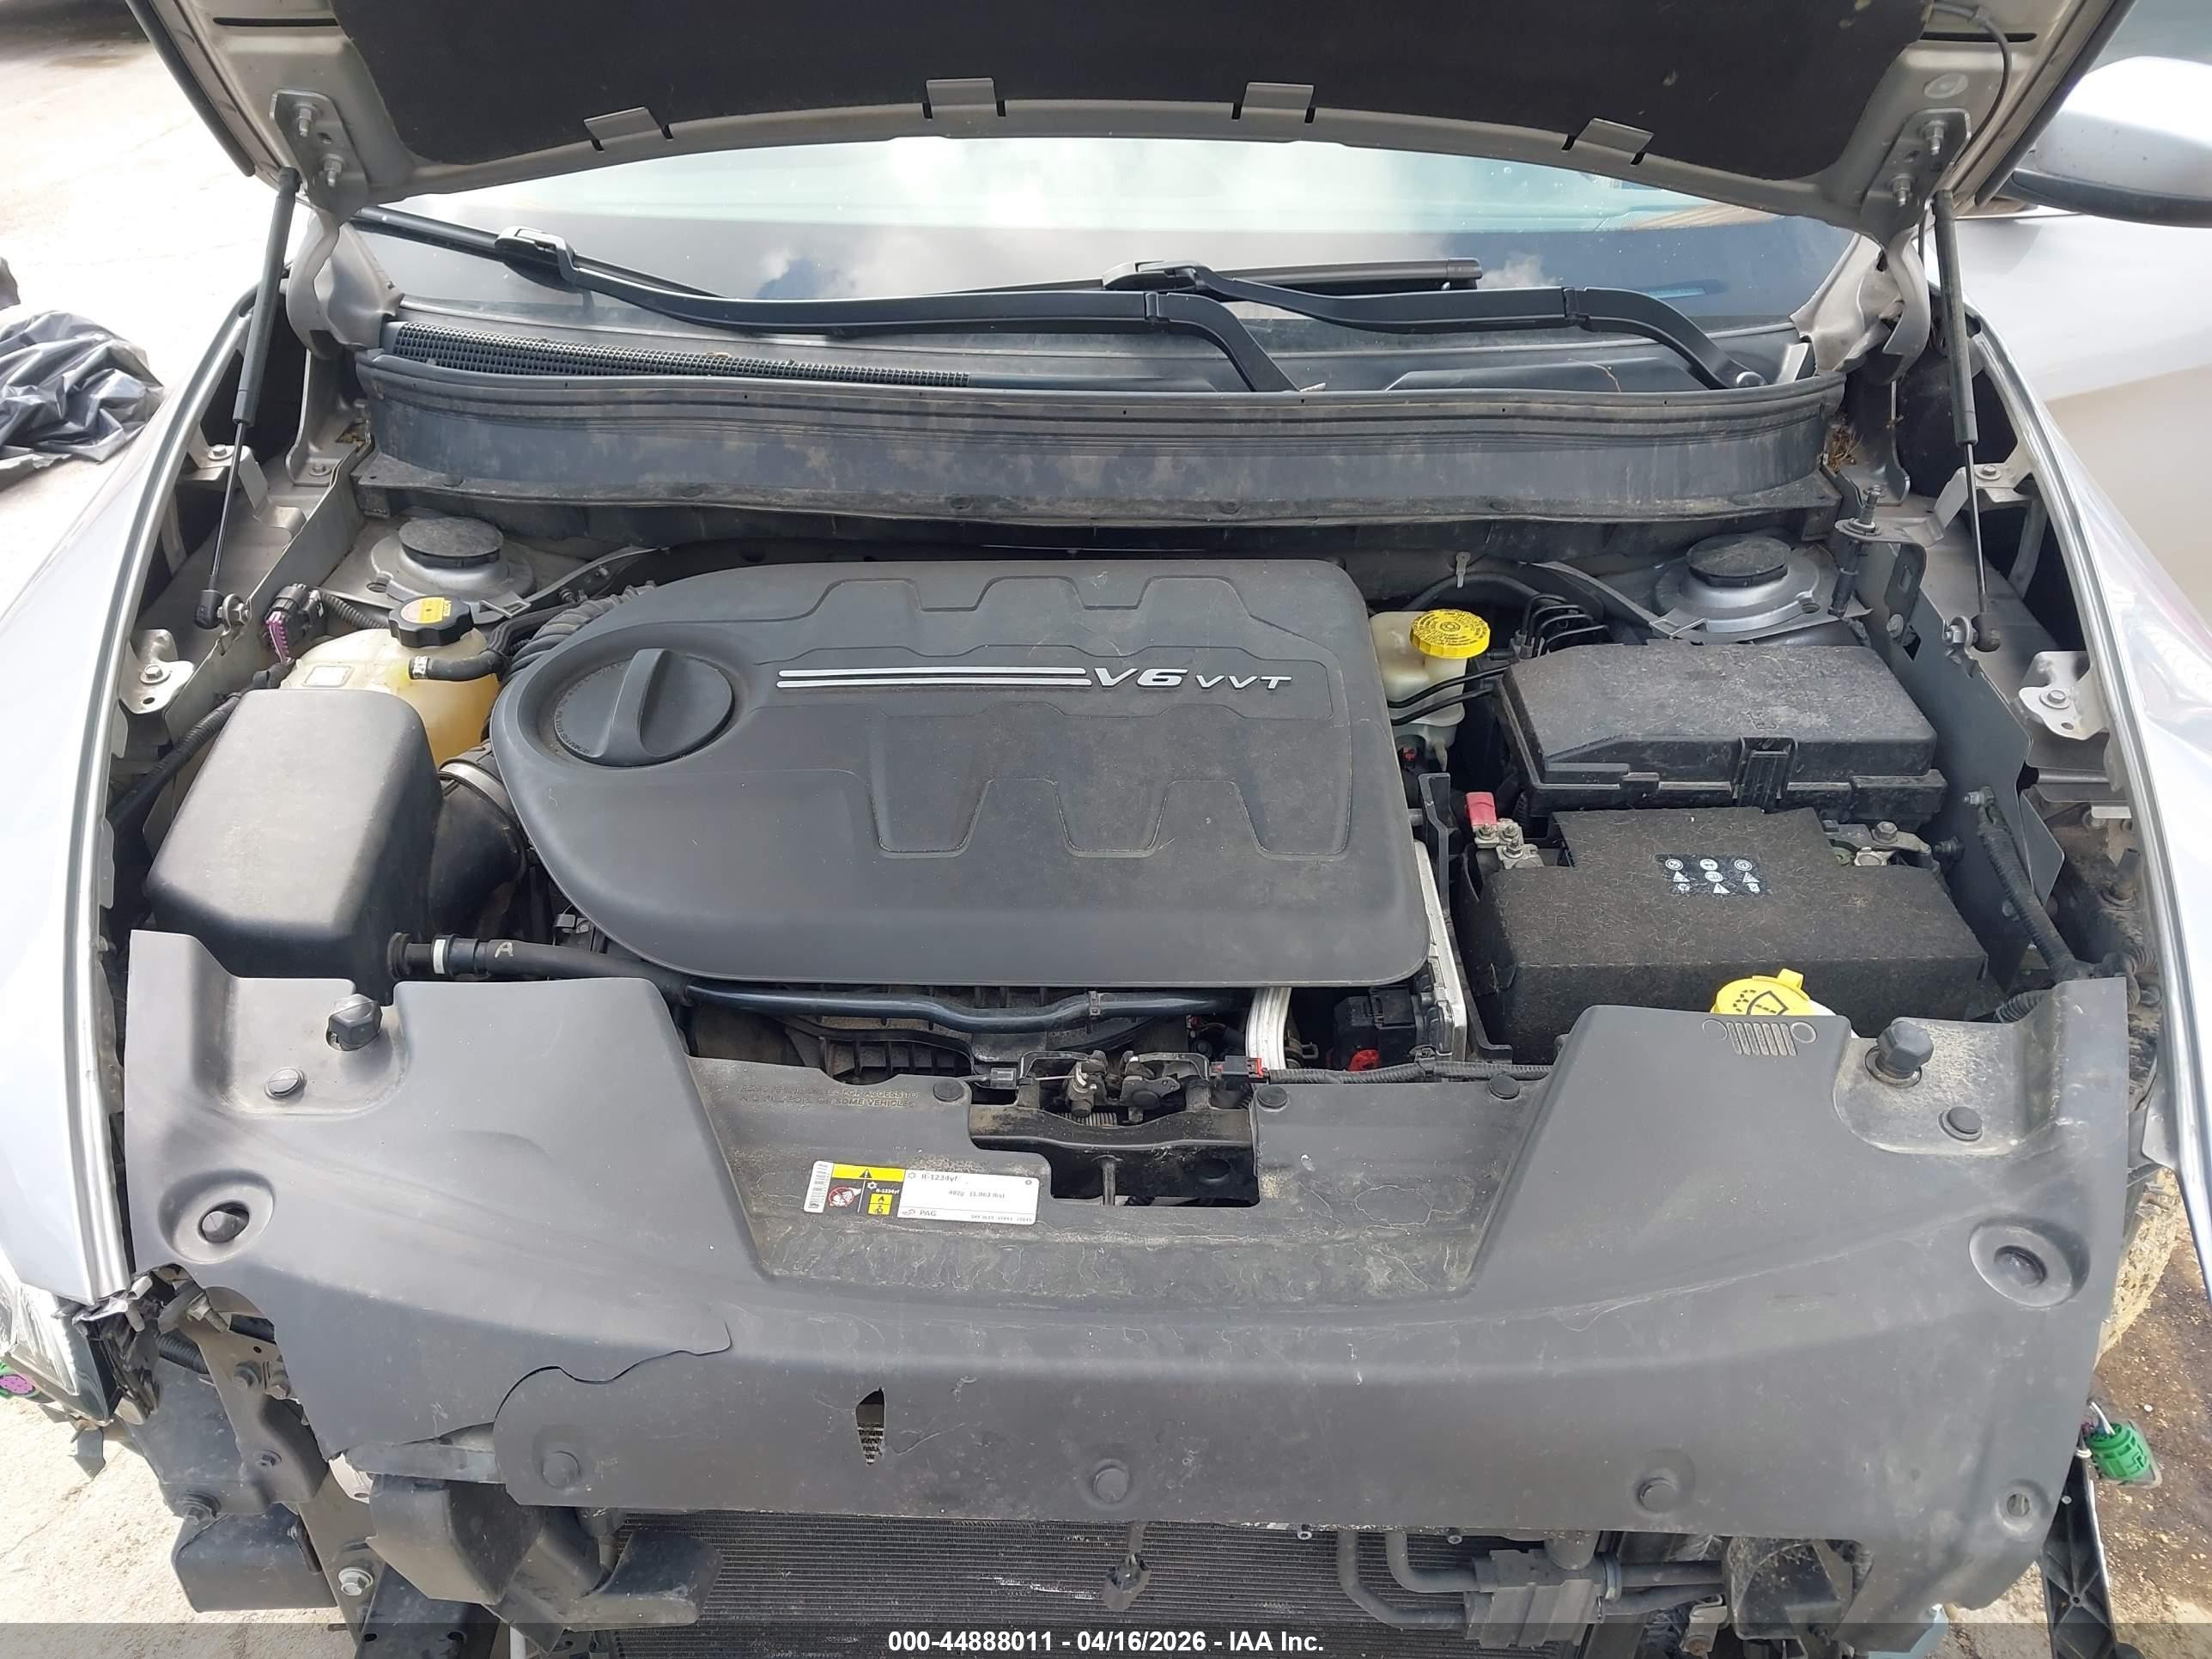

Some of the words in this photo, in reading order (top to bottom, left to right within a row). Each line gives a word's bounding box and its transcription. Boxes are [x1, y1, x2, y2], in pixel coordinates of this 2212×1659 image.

[1094, 667, 1188, 688] V6
[1195, 674, 1292, 690] VVT
[495, 941, 514, 958] A
[866, 1099, 915, 1108] VEHICLES
[920, 1209, 937, 1218] PAG
